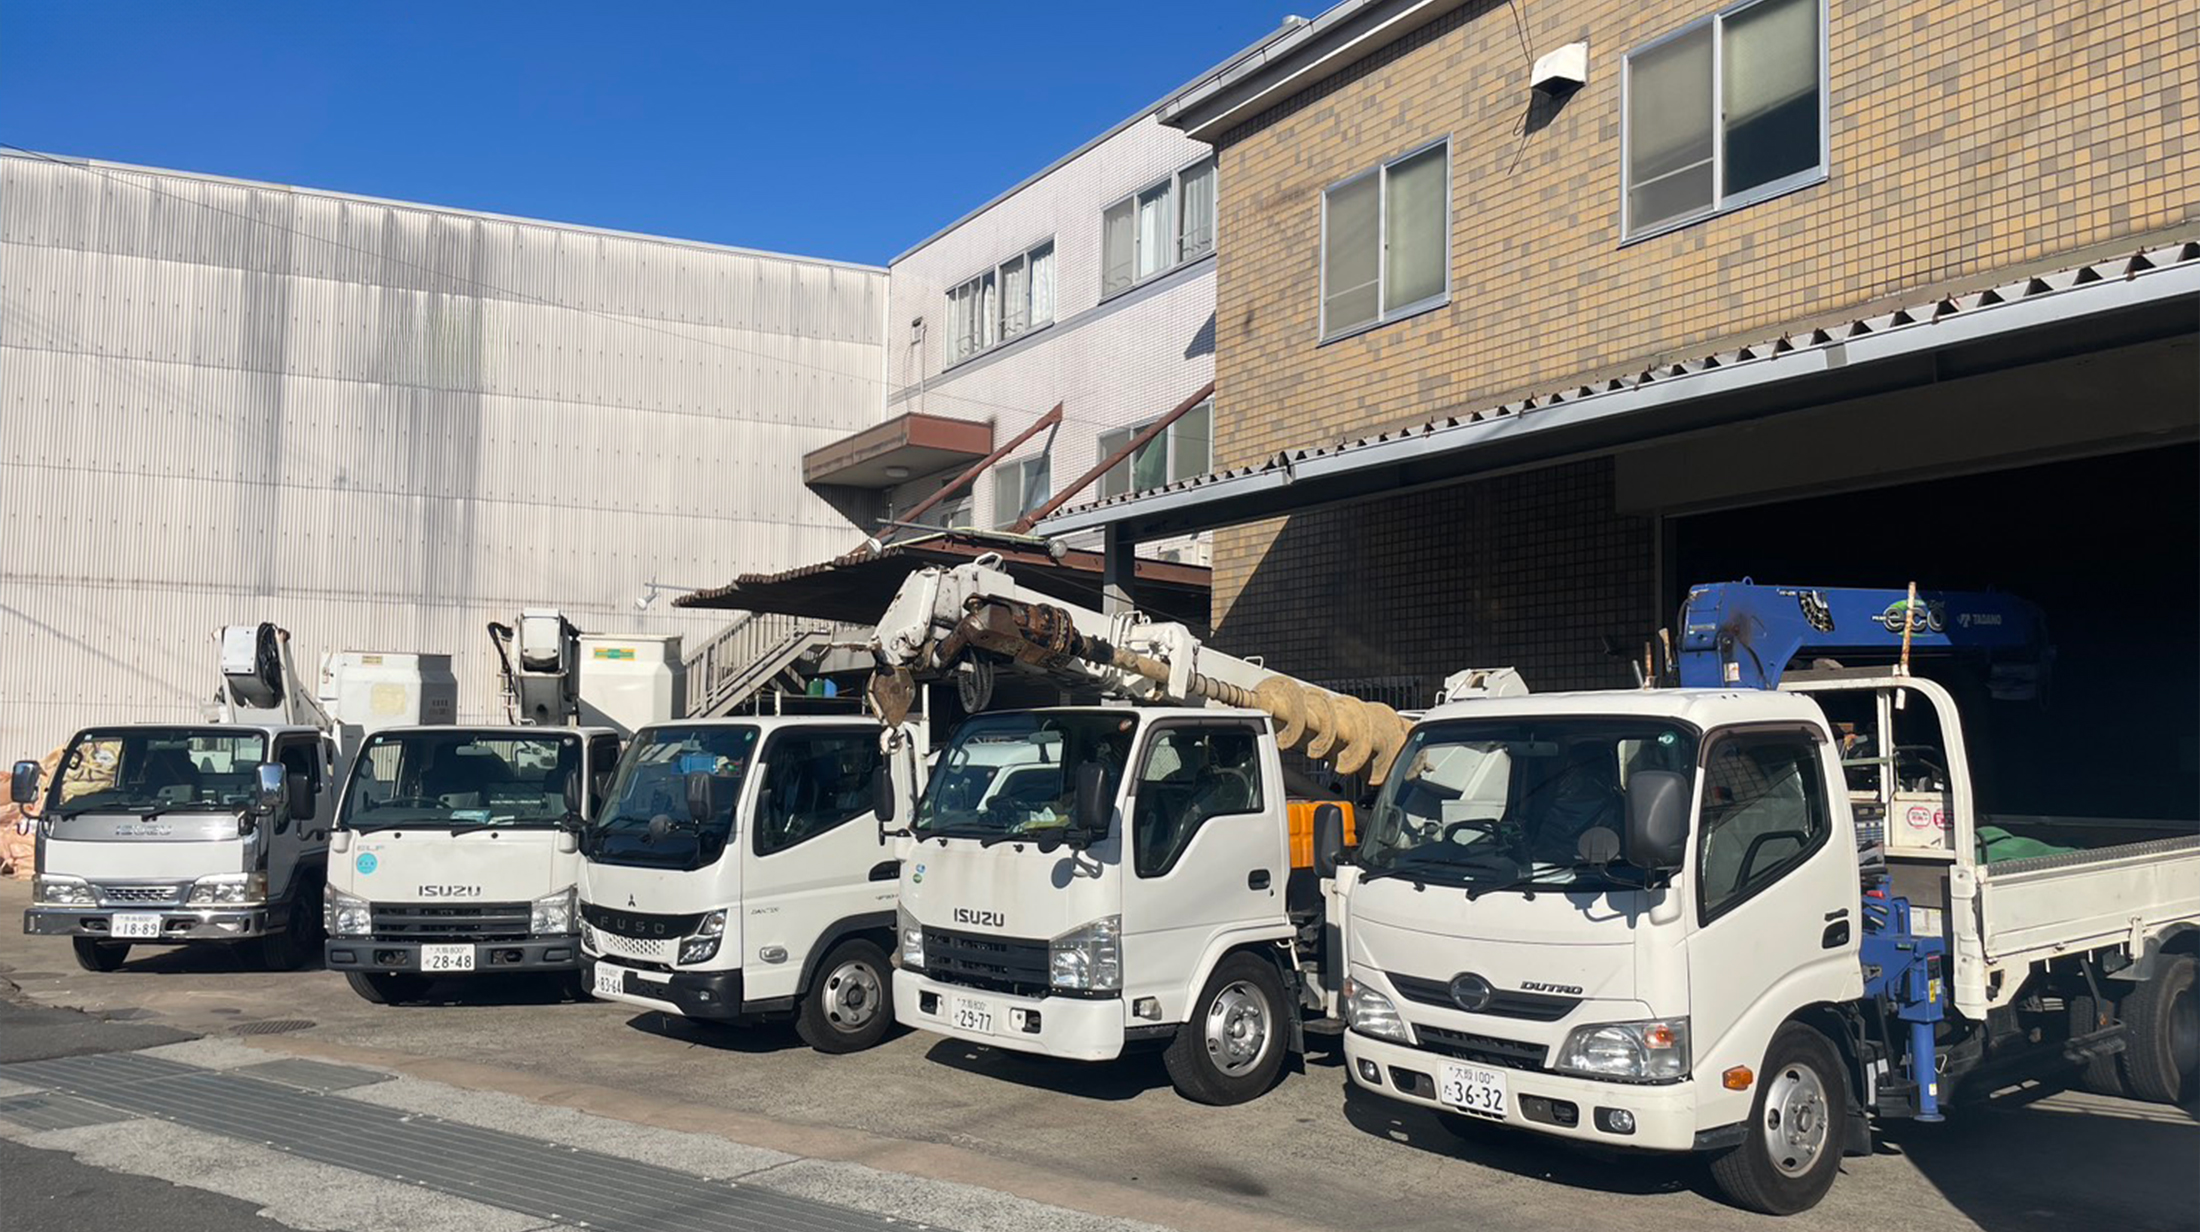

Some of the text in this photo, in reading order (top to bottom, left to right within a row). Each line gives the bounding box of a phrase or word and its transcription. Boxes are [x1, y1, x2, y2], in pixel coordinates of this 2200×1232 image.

[418, 885, 481, 897] ISUZU
[600, 916, 665, 935] FUSO
[954, 908, 1004, 928] ISUZU
[1520, 981, 1583, 995] DUTRO
